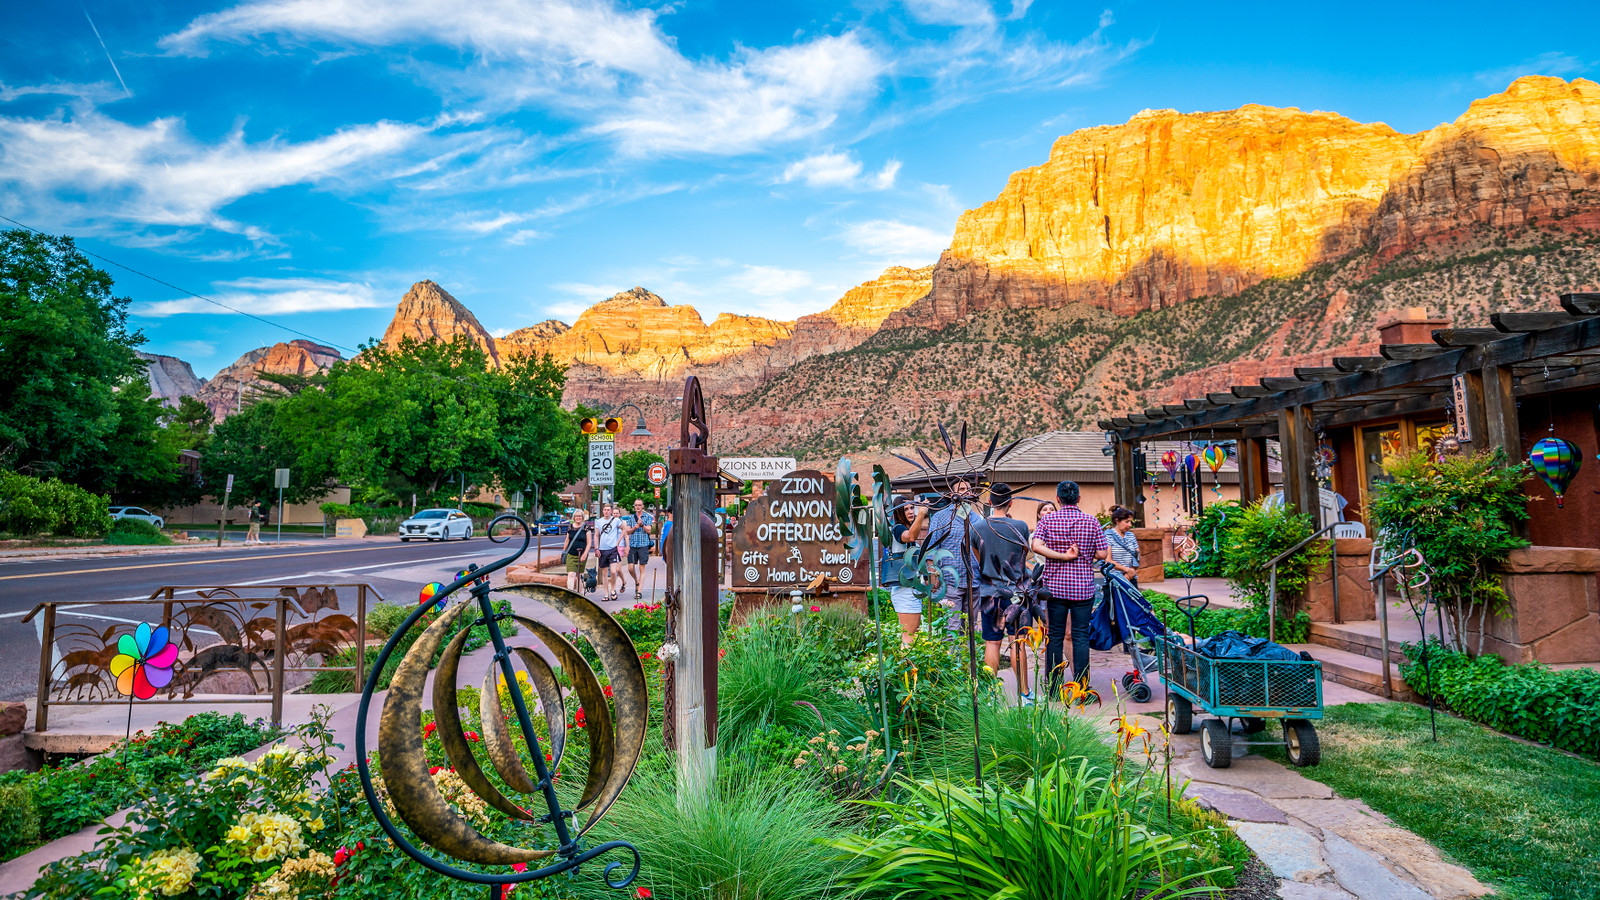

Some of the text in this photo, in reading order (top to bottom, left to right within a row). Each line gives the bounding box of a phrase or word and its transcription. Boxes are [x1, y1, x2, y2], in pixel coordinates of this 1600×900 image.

[1456, 391, 1465, 426] 933
[591, 458, 612, 470] 20
[722, 461, 792, 470] ZIONS BANK
[781, 477, 824, 494] ZION
[770, 500, 832, 518] CANYON
[757, 523, 843, 542] OFFERINGS
[741, 550, 769, 565] Gifts
[767, 567, 796, 582] Home
